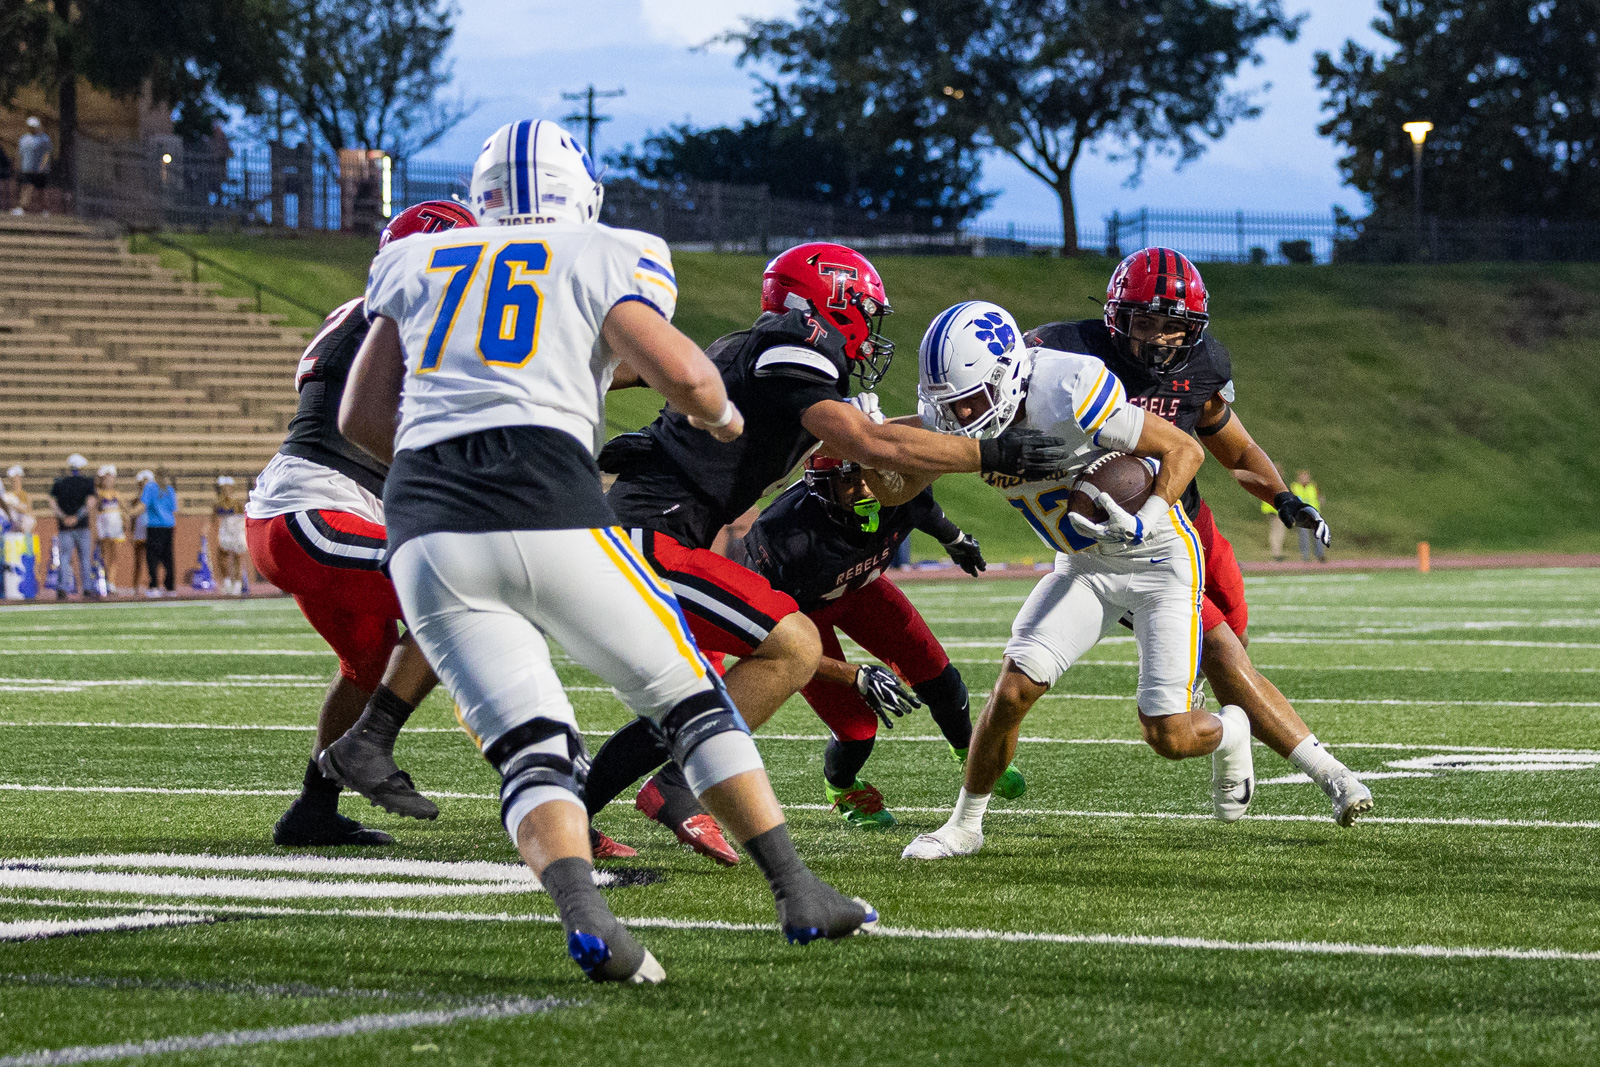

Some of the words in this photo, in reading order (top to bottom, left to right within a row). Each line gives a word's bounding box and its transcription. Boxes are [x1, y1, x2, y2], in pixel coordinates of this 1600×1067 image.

[416, 240, 553, 375] 76
[818, 262, 858, 310] T
[804, 318, 828, 347] T
[1006, 485, 1099, 554] 12
[836, 547, 890, 585] REBELS
